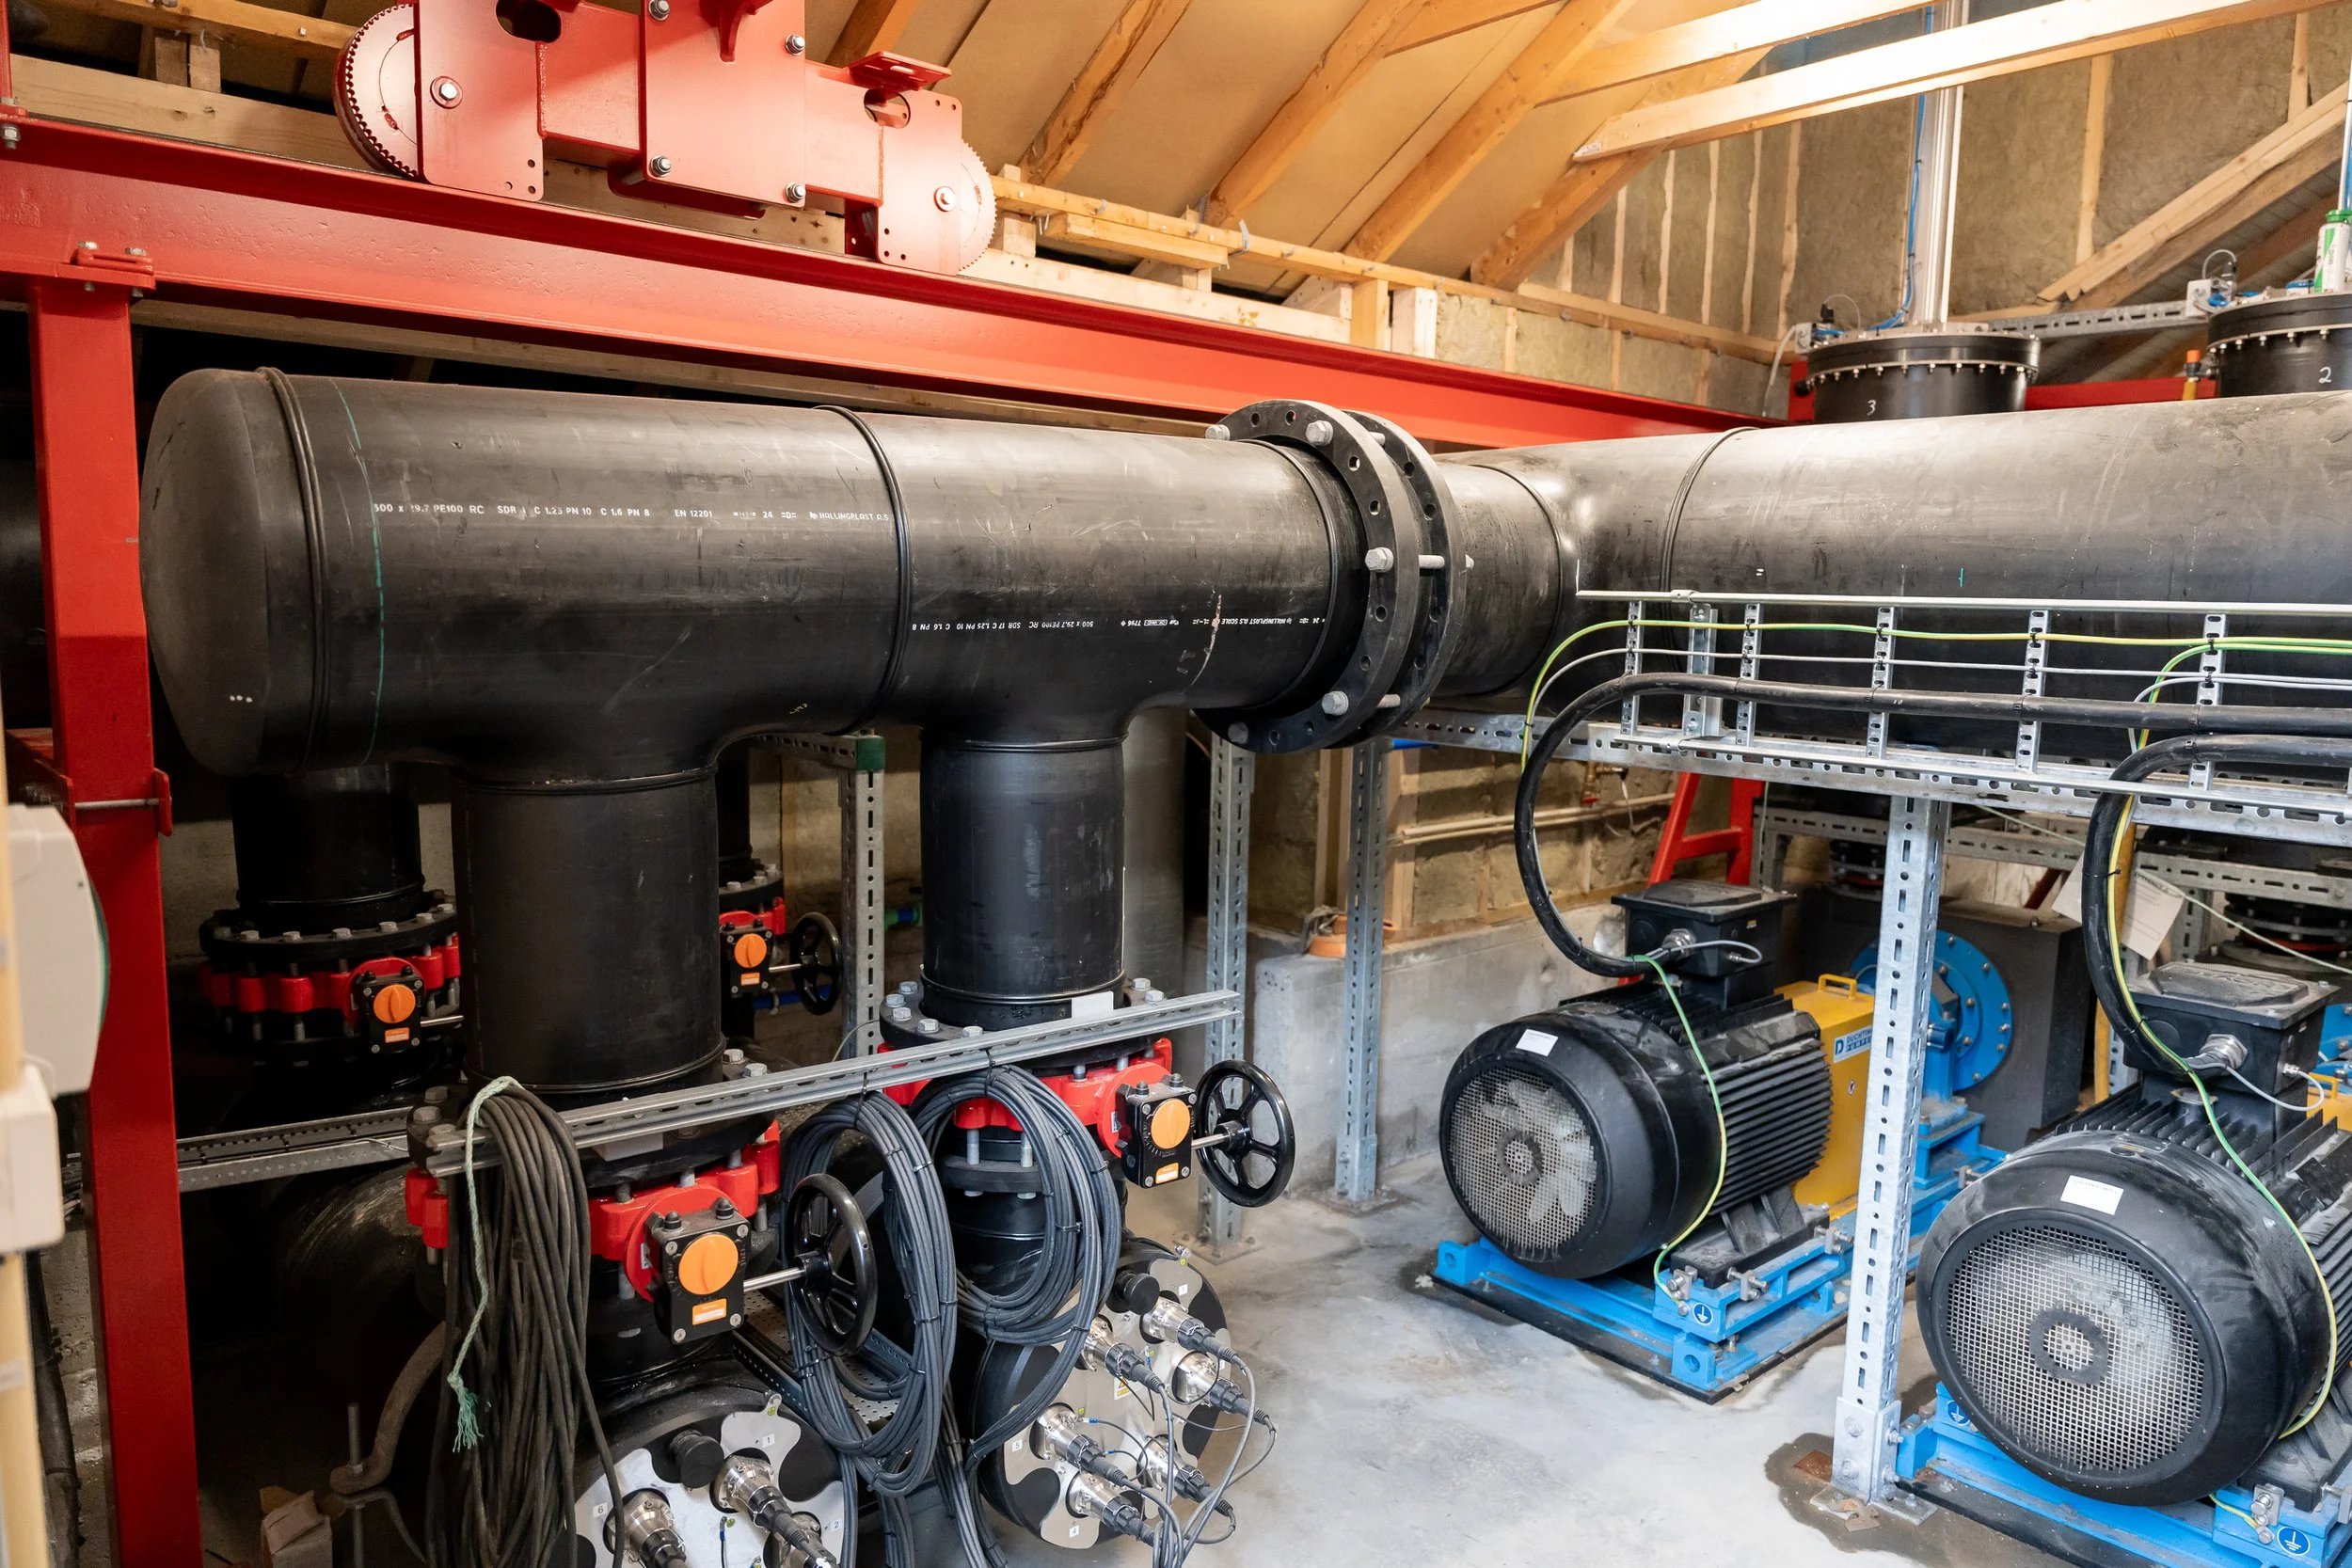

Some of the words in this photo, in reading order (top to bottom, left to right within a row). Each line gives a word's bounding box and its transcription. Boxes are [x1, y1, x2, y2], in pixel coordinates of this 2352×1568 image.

[2318, 366, 2332, 384] 2
[1867, 399, 1877, 417] 3
[432, 504, 464, 514] PE100
[469, 505, 485, 515] RC
[497, 505, 516, 515] SDR
[533, 506, 542, 515] C
[544, 506, 564, 515] 1.25
[565, 507, 580, 516] PN
[581, 507, 593, 516] 10
[599, 508, 608, 516] C
[610, 508, 624, 516] 1.6
[627, 509, 641, 517] PN
[644, 509, 651, 517] 8
[674, 509, 687, 518] EN
[689, 510, 713, 519] 12201
[817, 512, 874, 521] HALLINGPLAST
[919, 623, 930, 631] PN
[933, 623, 944, 631] 1.6
[945, 623, 951, 631] C
[956, 622, 964, 630] 10
[965, 622, 977, 630] PN
[977, 622, 991, 630] 1.25
[992, 622, 998, 630] C
[997, 622, 1006, 630] 17
[1008, 621, 1022, 629] SDR
[1028, 621, 1040, 629] RC
[1041, 621, 1060, 629] PE100
[1061, 620, 1075, 628] 29.7
[1082, 620, 1095, 628] 500
